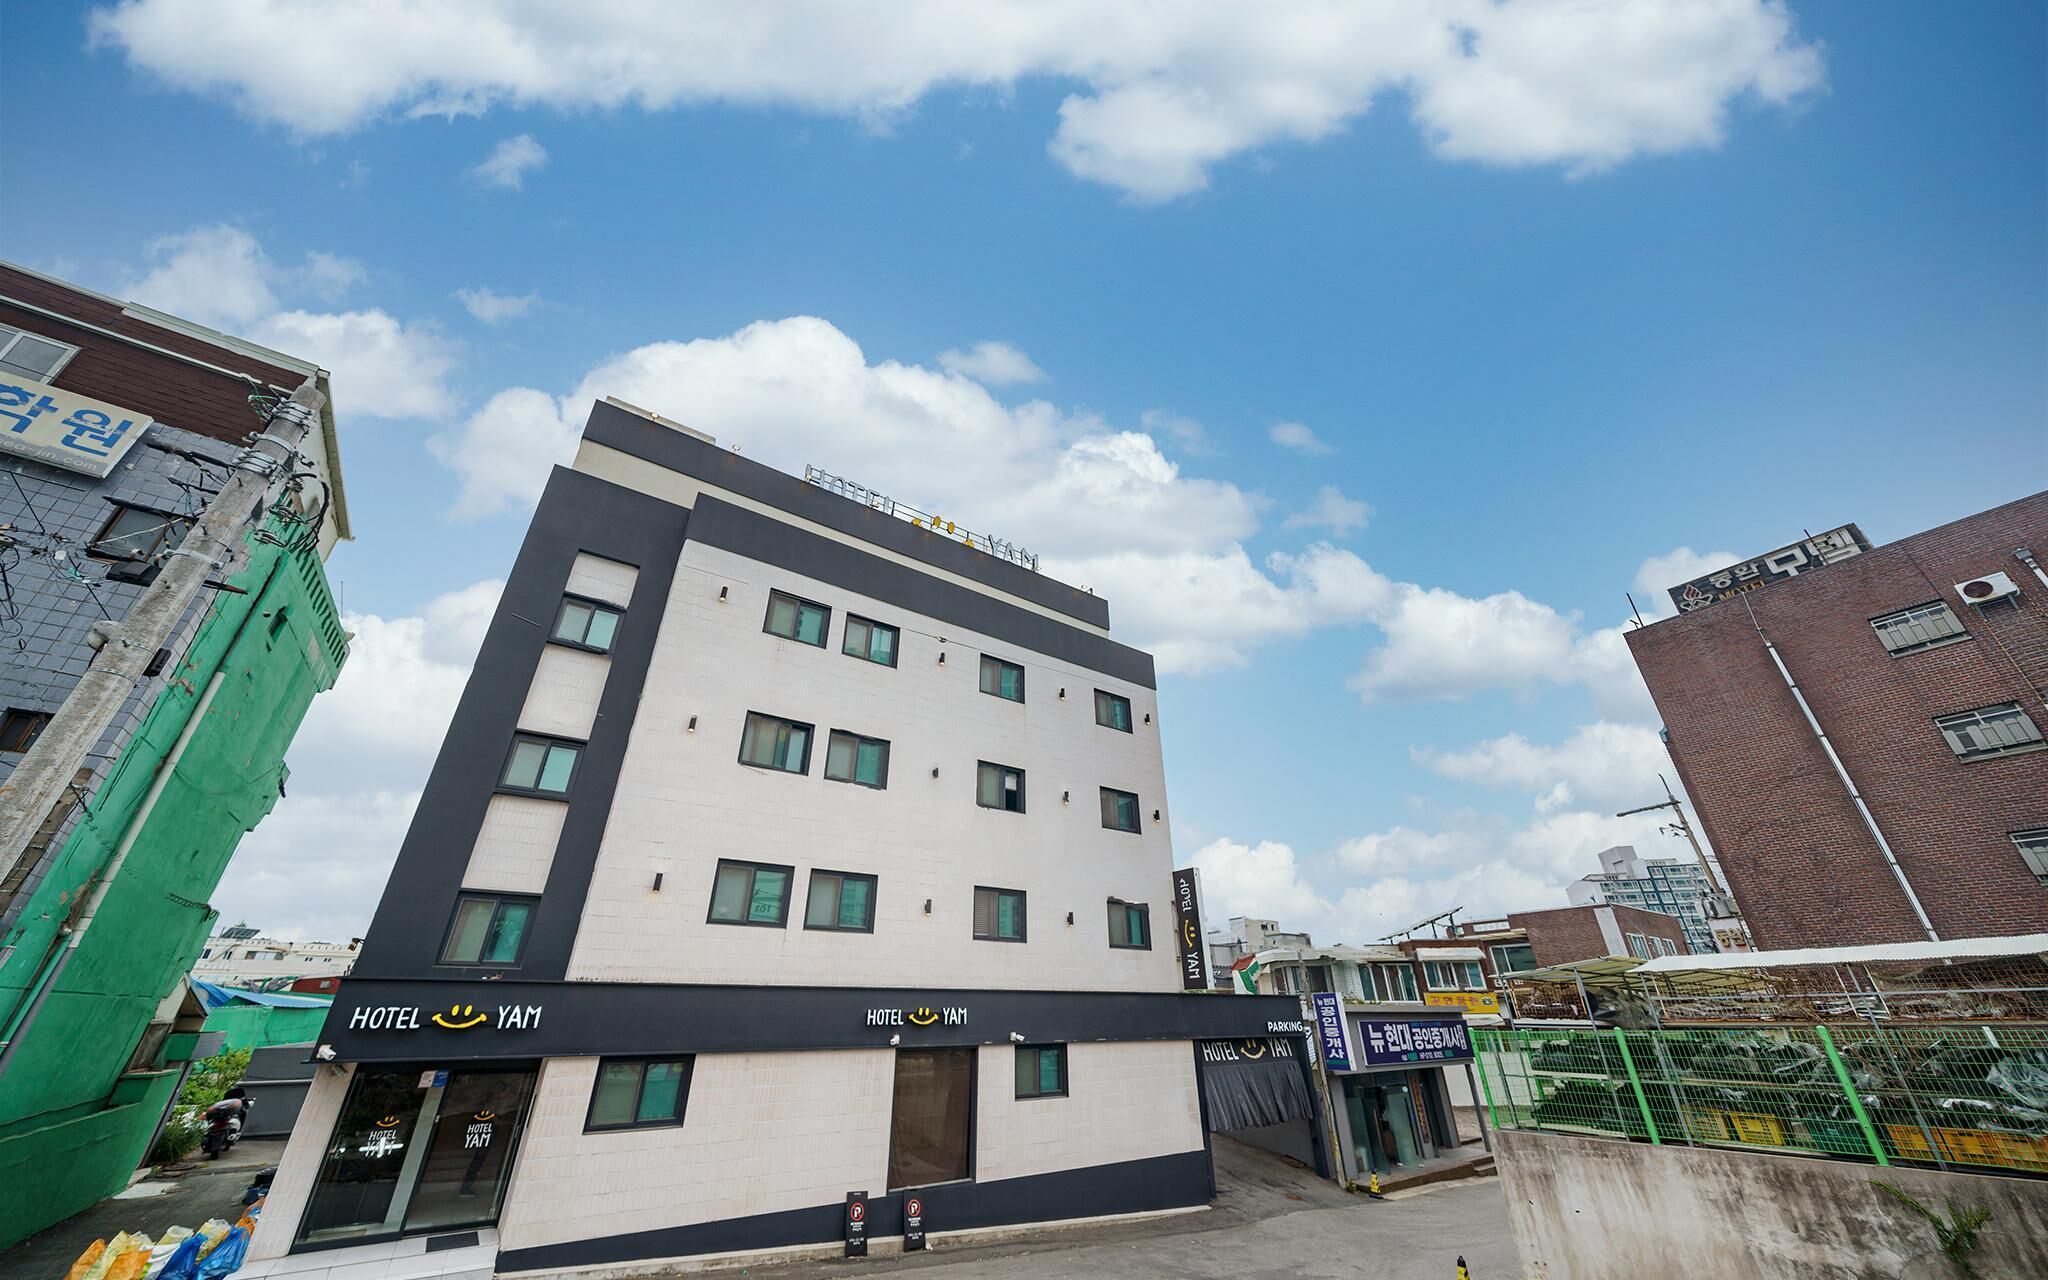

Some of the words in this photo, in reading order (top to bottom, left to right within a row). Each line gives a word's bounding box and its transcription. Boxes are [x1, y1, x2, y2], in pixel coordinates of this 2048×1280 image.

[988, 535, 1039, 571] YAM
[1187, 952, 1200, 979] YAM
[349, 1006, 420, 1030] HOTEL
[497, 1005, 543, 1030] YAM
[866, 1008, 904, 1026] HOTEL
[942, 1007, 968, 1025] YAM
[1267, 1021, 1303, 1032] PARKING
[1201, 1041, 1240, 1062] HOTEL
[1266, 1036, 1293, 1057] YAM
[368, 1129, 397, 1141] HOTEL
[467, 1123, 492, 1134] HOTEL
[465, 1133, 491, 1149] YAM
